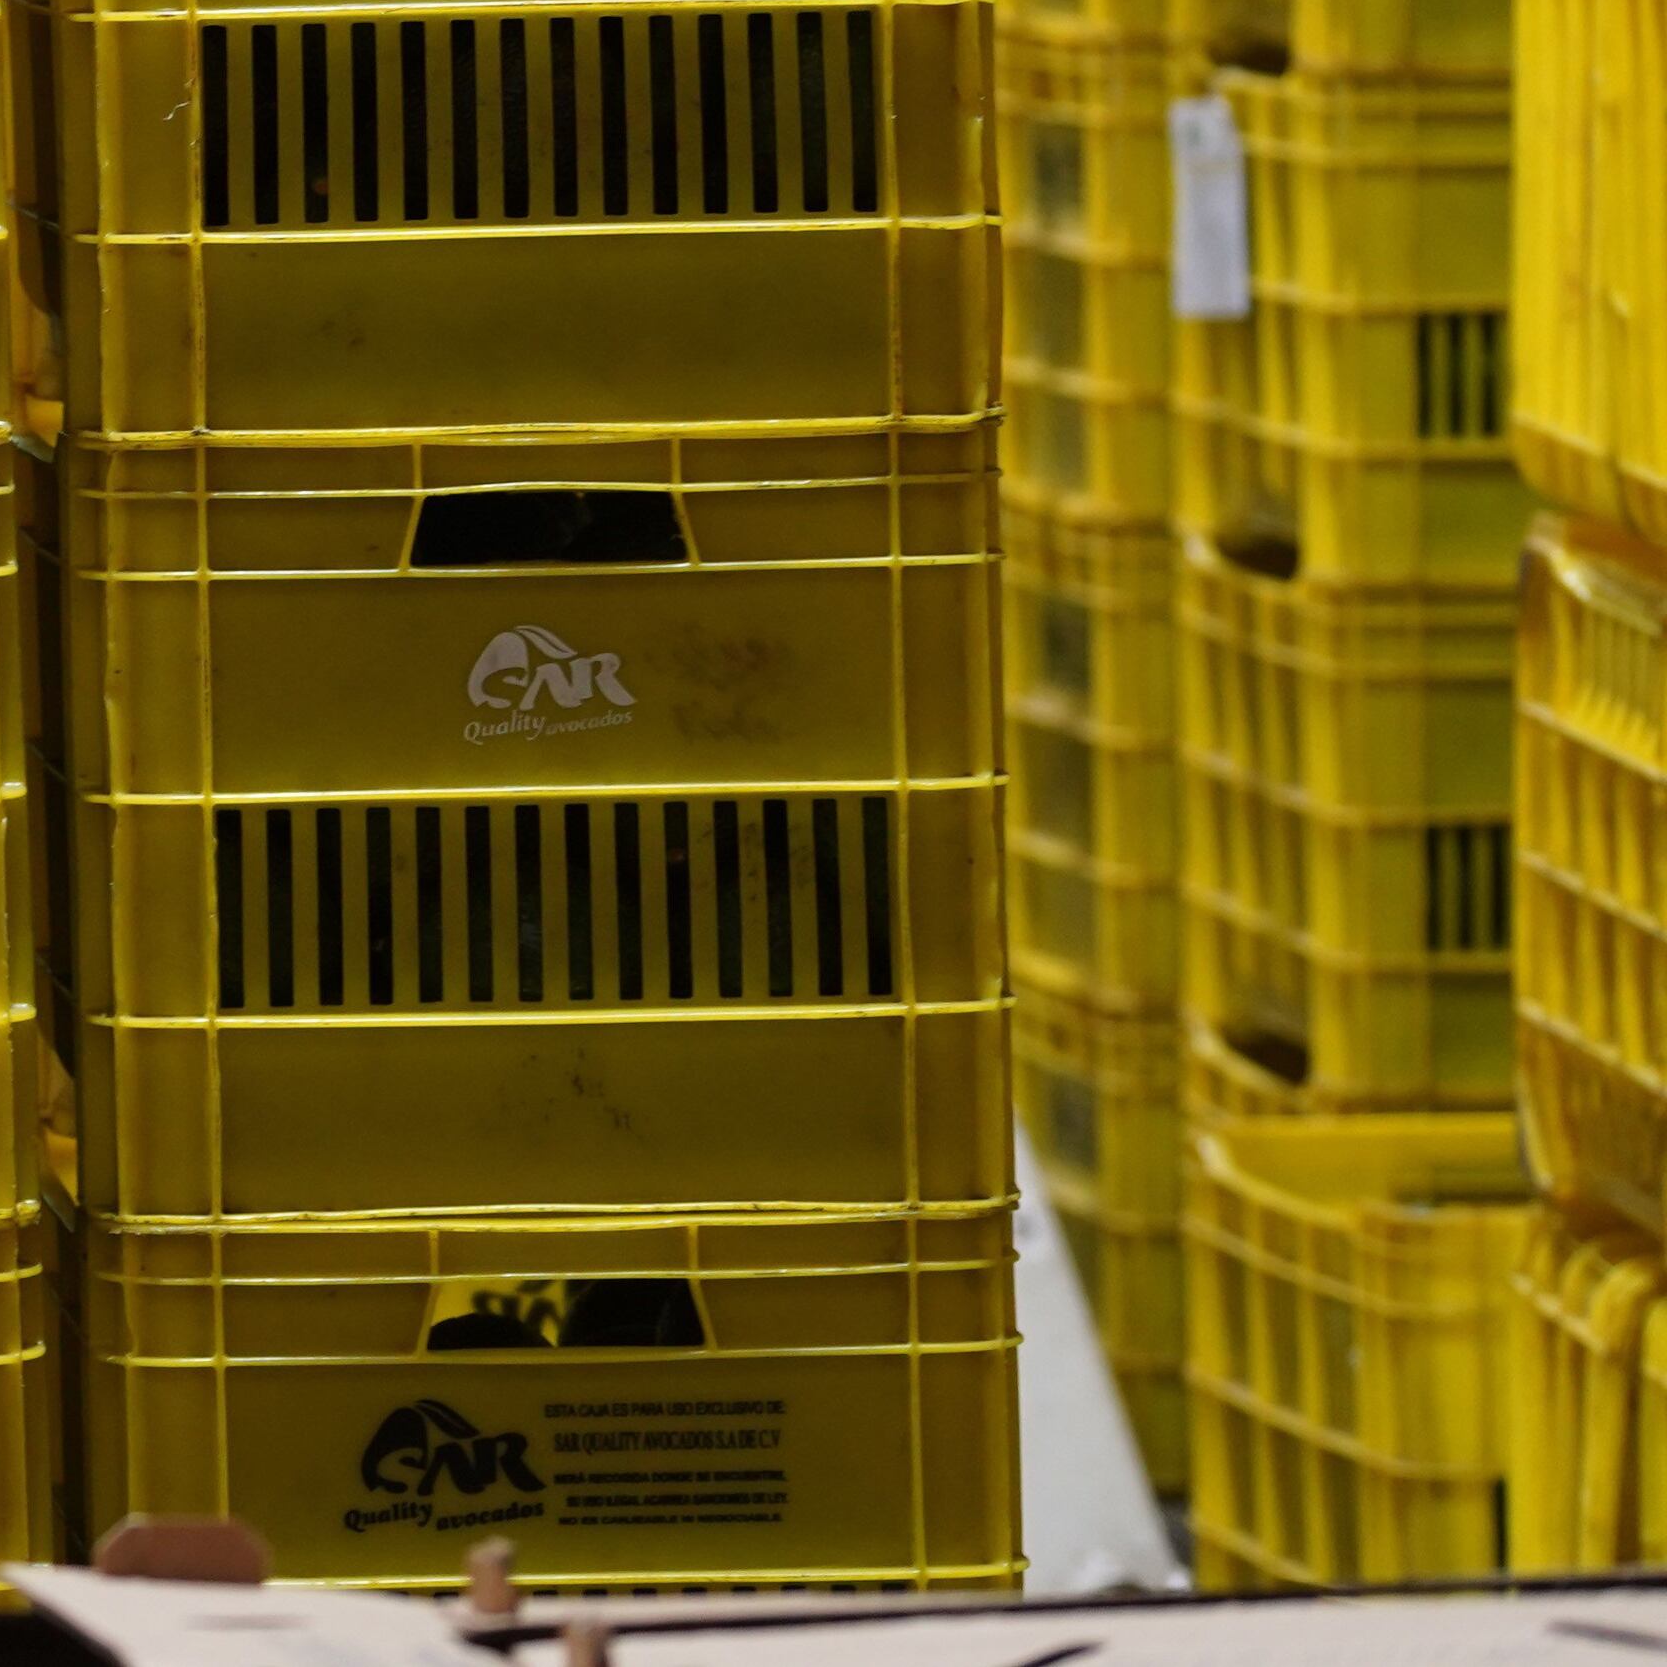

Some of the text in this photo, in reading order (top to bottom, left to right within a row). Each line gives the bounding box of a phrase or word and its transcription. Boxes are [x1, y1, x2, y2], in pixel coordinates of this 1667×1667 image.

[462, 709, 634, 745] Quality avocados
[545, 1403, 576, 1418] ESTA
[578, 1403, 609, 1418] CAJA
[612, 1402, 629, 1417] ES
[631, 1402, 664, 1417] PARA
[666, 1401, 693, 1416] USO
[695, 1400, 764, 1416] EXCLUSIVO
[554, 1431, 580, 1452] SAR
[582, 1430, 643, 1455] QUALITY
[643, 1430, 714, 1451] AVOCADOS
[738, 1429, 757, 1450] DE
[343, 1501, 544, 1533] Quality avocados
